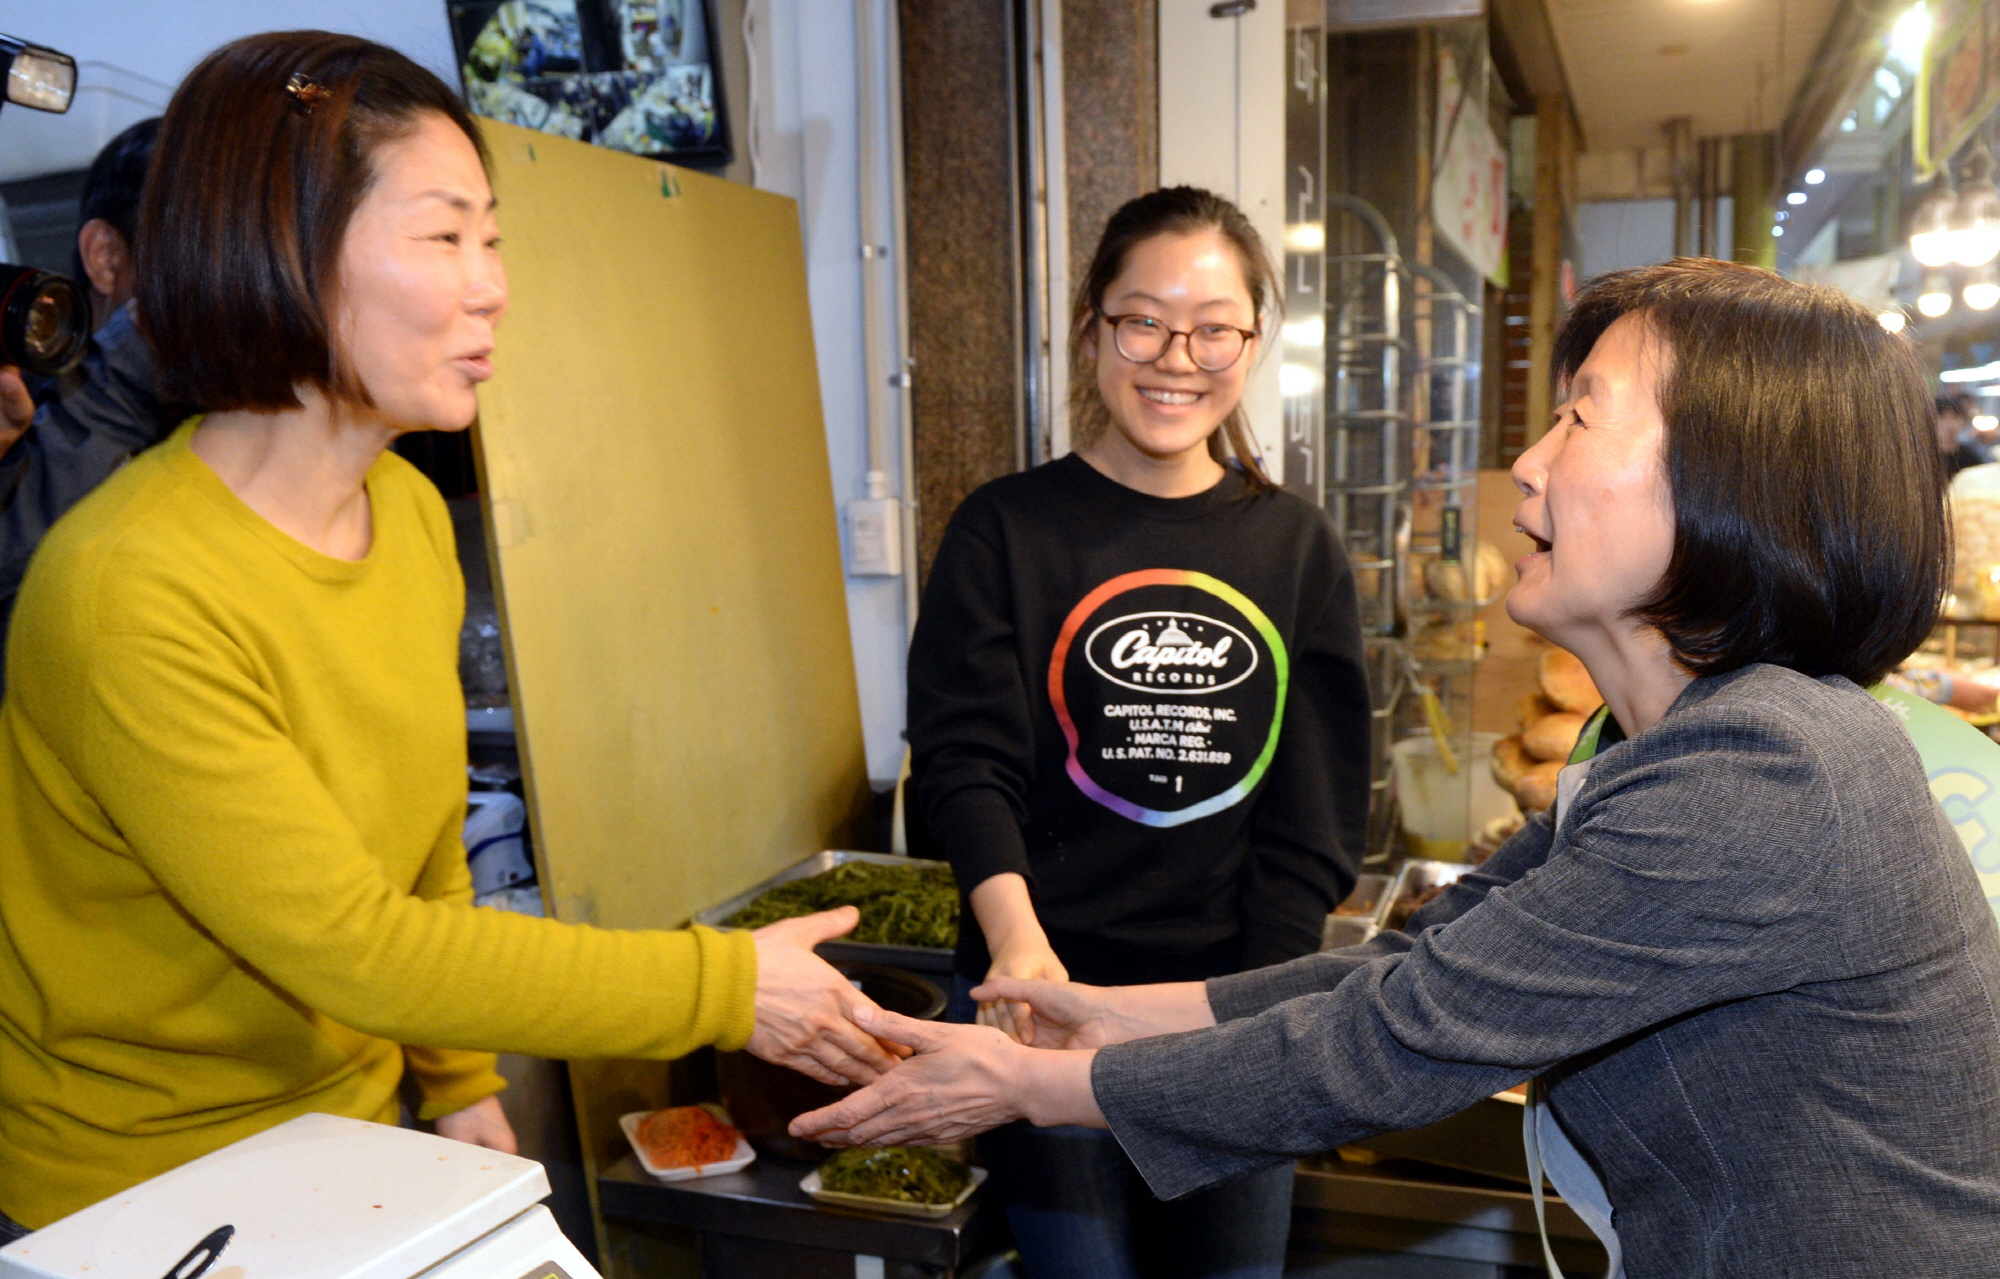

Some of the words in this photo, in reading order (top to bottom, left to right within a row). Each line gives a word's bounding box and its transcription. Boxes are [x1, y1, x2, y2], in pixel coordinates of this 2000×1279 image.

[1111, 630, 1233, 672] Capitol
[1132, 672, 1216, 685] RECORDS
[1103, 704, 1154, 717] CAPITOL
[1213, 708, 1237, 721] INC.
[1134, 733, 1177, 746] MARCA
[1179, 735, 1206, 748] REG.
[1128, 747, 1154, 759] PAT.
[1155, 747, 1176, 760] NO.
[1175, 775, 1183, 793] 1
